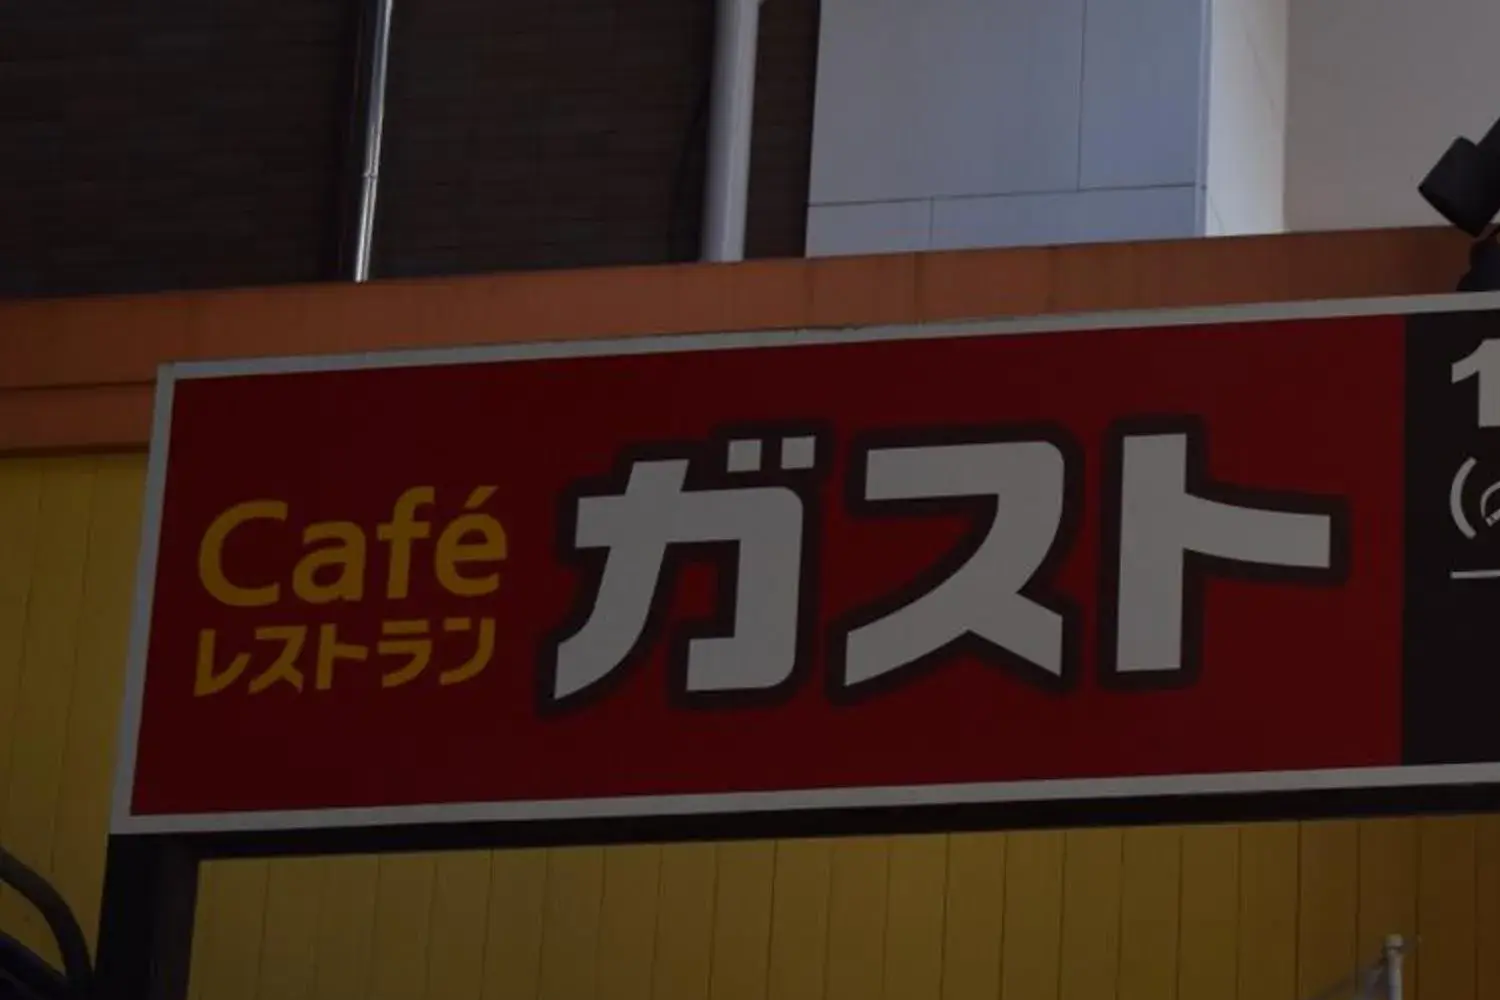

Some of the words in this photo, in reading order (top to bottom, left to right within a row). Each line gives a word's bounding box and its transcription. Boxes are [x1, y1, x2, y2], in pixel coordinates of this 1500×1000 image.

[197, 484, 509, 608] Café
[552, 431, 1332, 701] ガスト
[193, 614, 496, 698] レストラン
